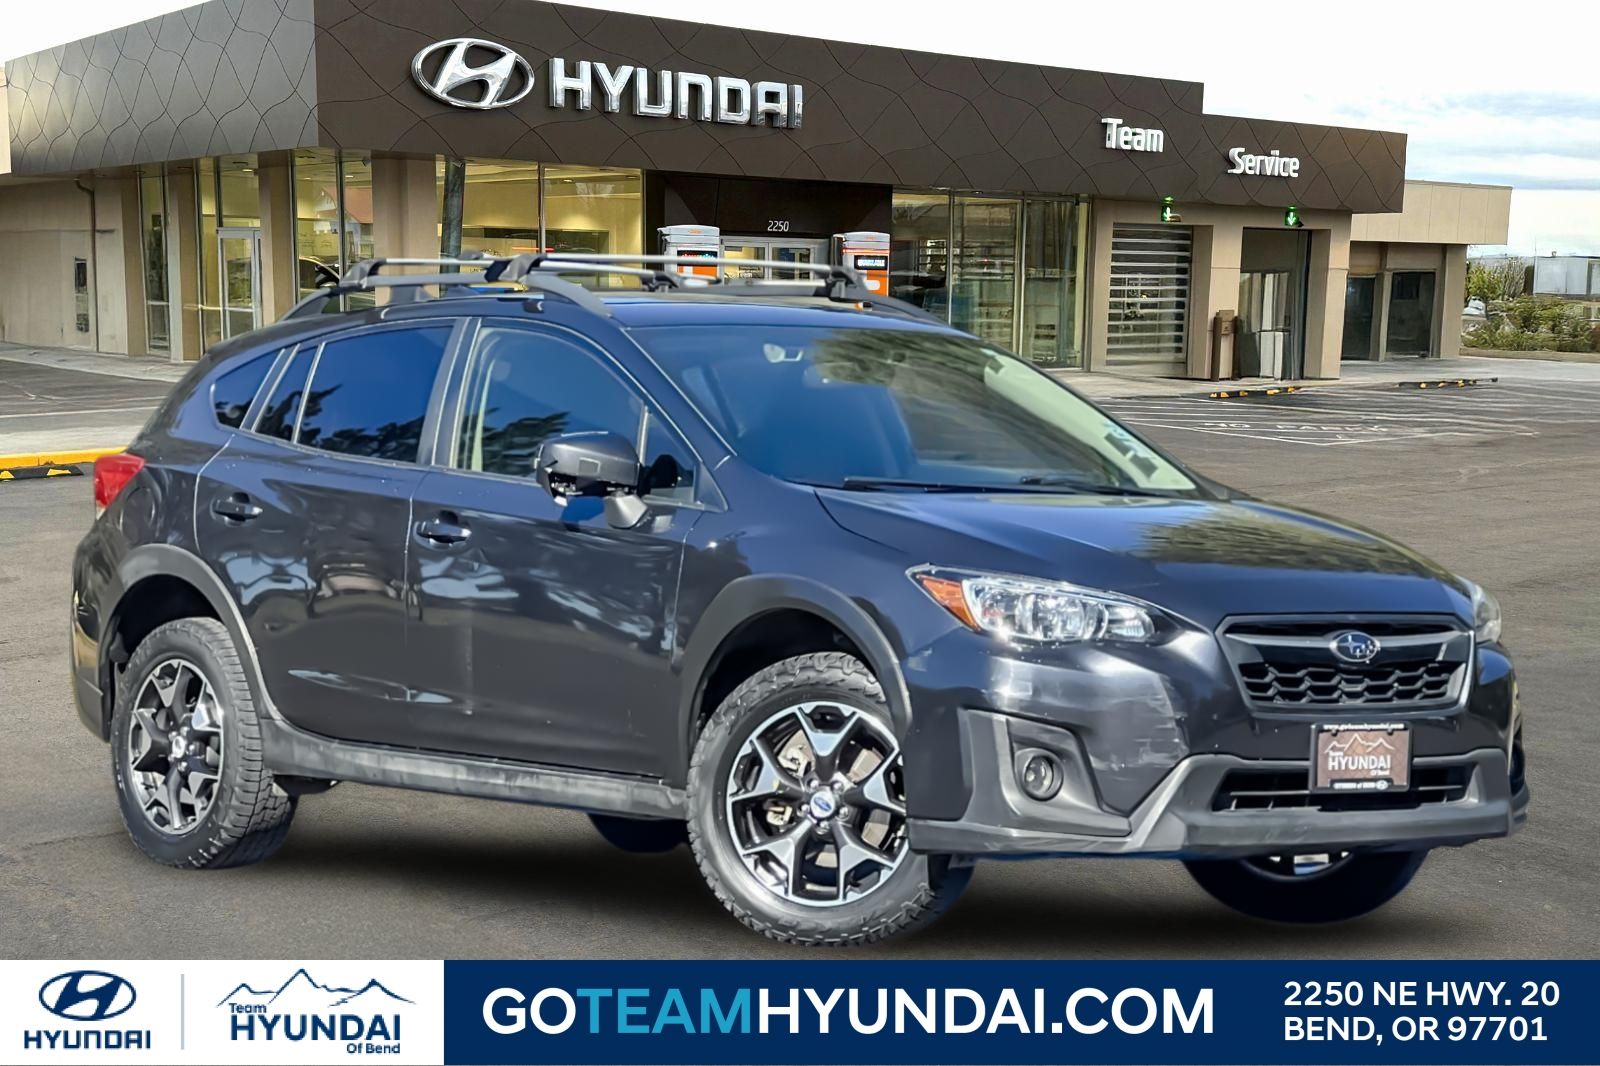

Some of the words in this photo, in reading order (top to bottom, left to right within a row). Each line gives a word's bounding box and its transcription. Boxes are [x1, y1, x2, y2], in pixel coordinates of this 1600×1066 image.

[549, 57, 804, 128] HYUNDAI
[1101, 117, 1164, 153] Team
[1227, 147, 1300, 178] Service
[767, 220, 790, 232] 2250
[1328, 755, 1391, 771] HYUNDAI
